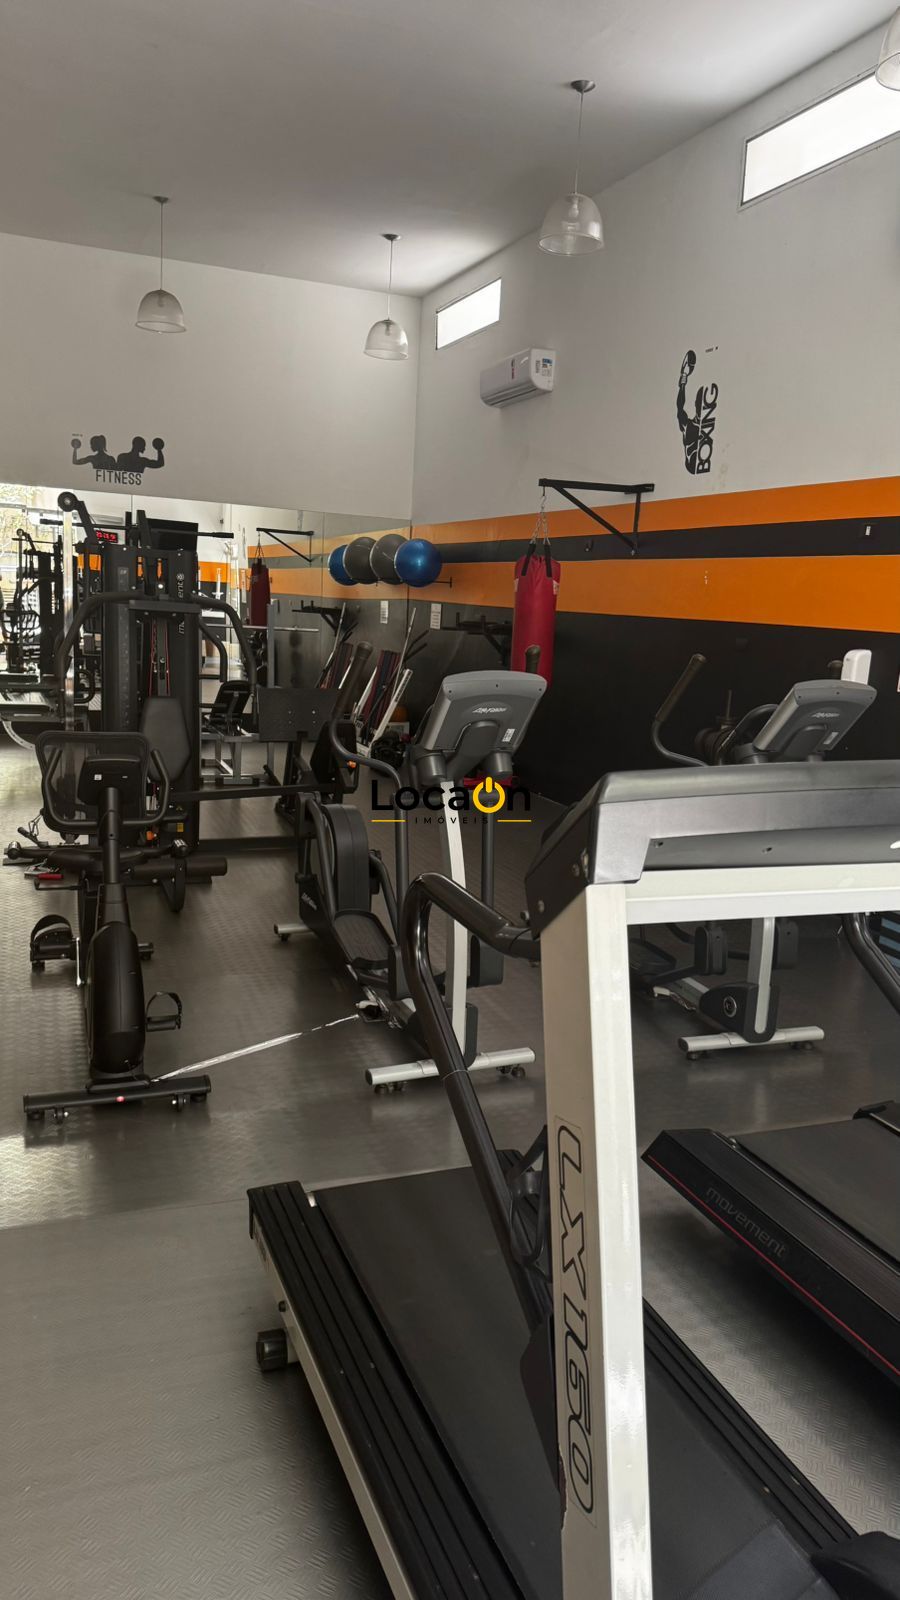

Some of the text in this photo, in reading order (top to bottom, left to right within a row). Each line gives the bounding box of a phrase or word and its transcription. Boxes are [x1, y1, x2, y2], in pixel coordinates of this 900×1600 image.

[696, 383, 718, 474] BOXING
[95, 469, 142, 486] FITNESS
[706, 1187, 786, 1258] movement
[557, 1125, 594, 1514] LX160
